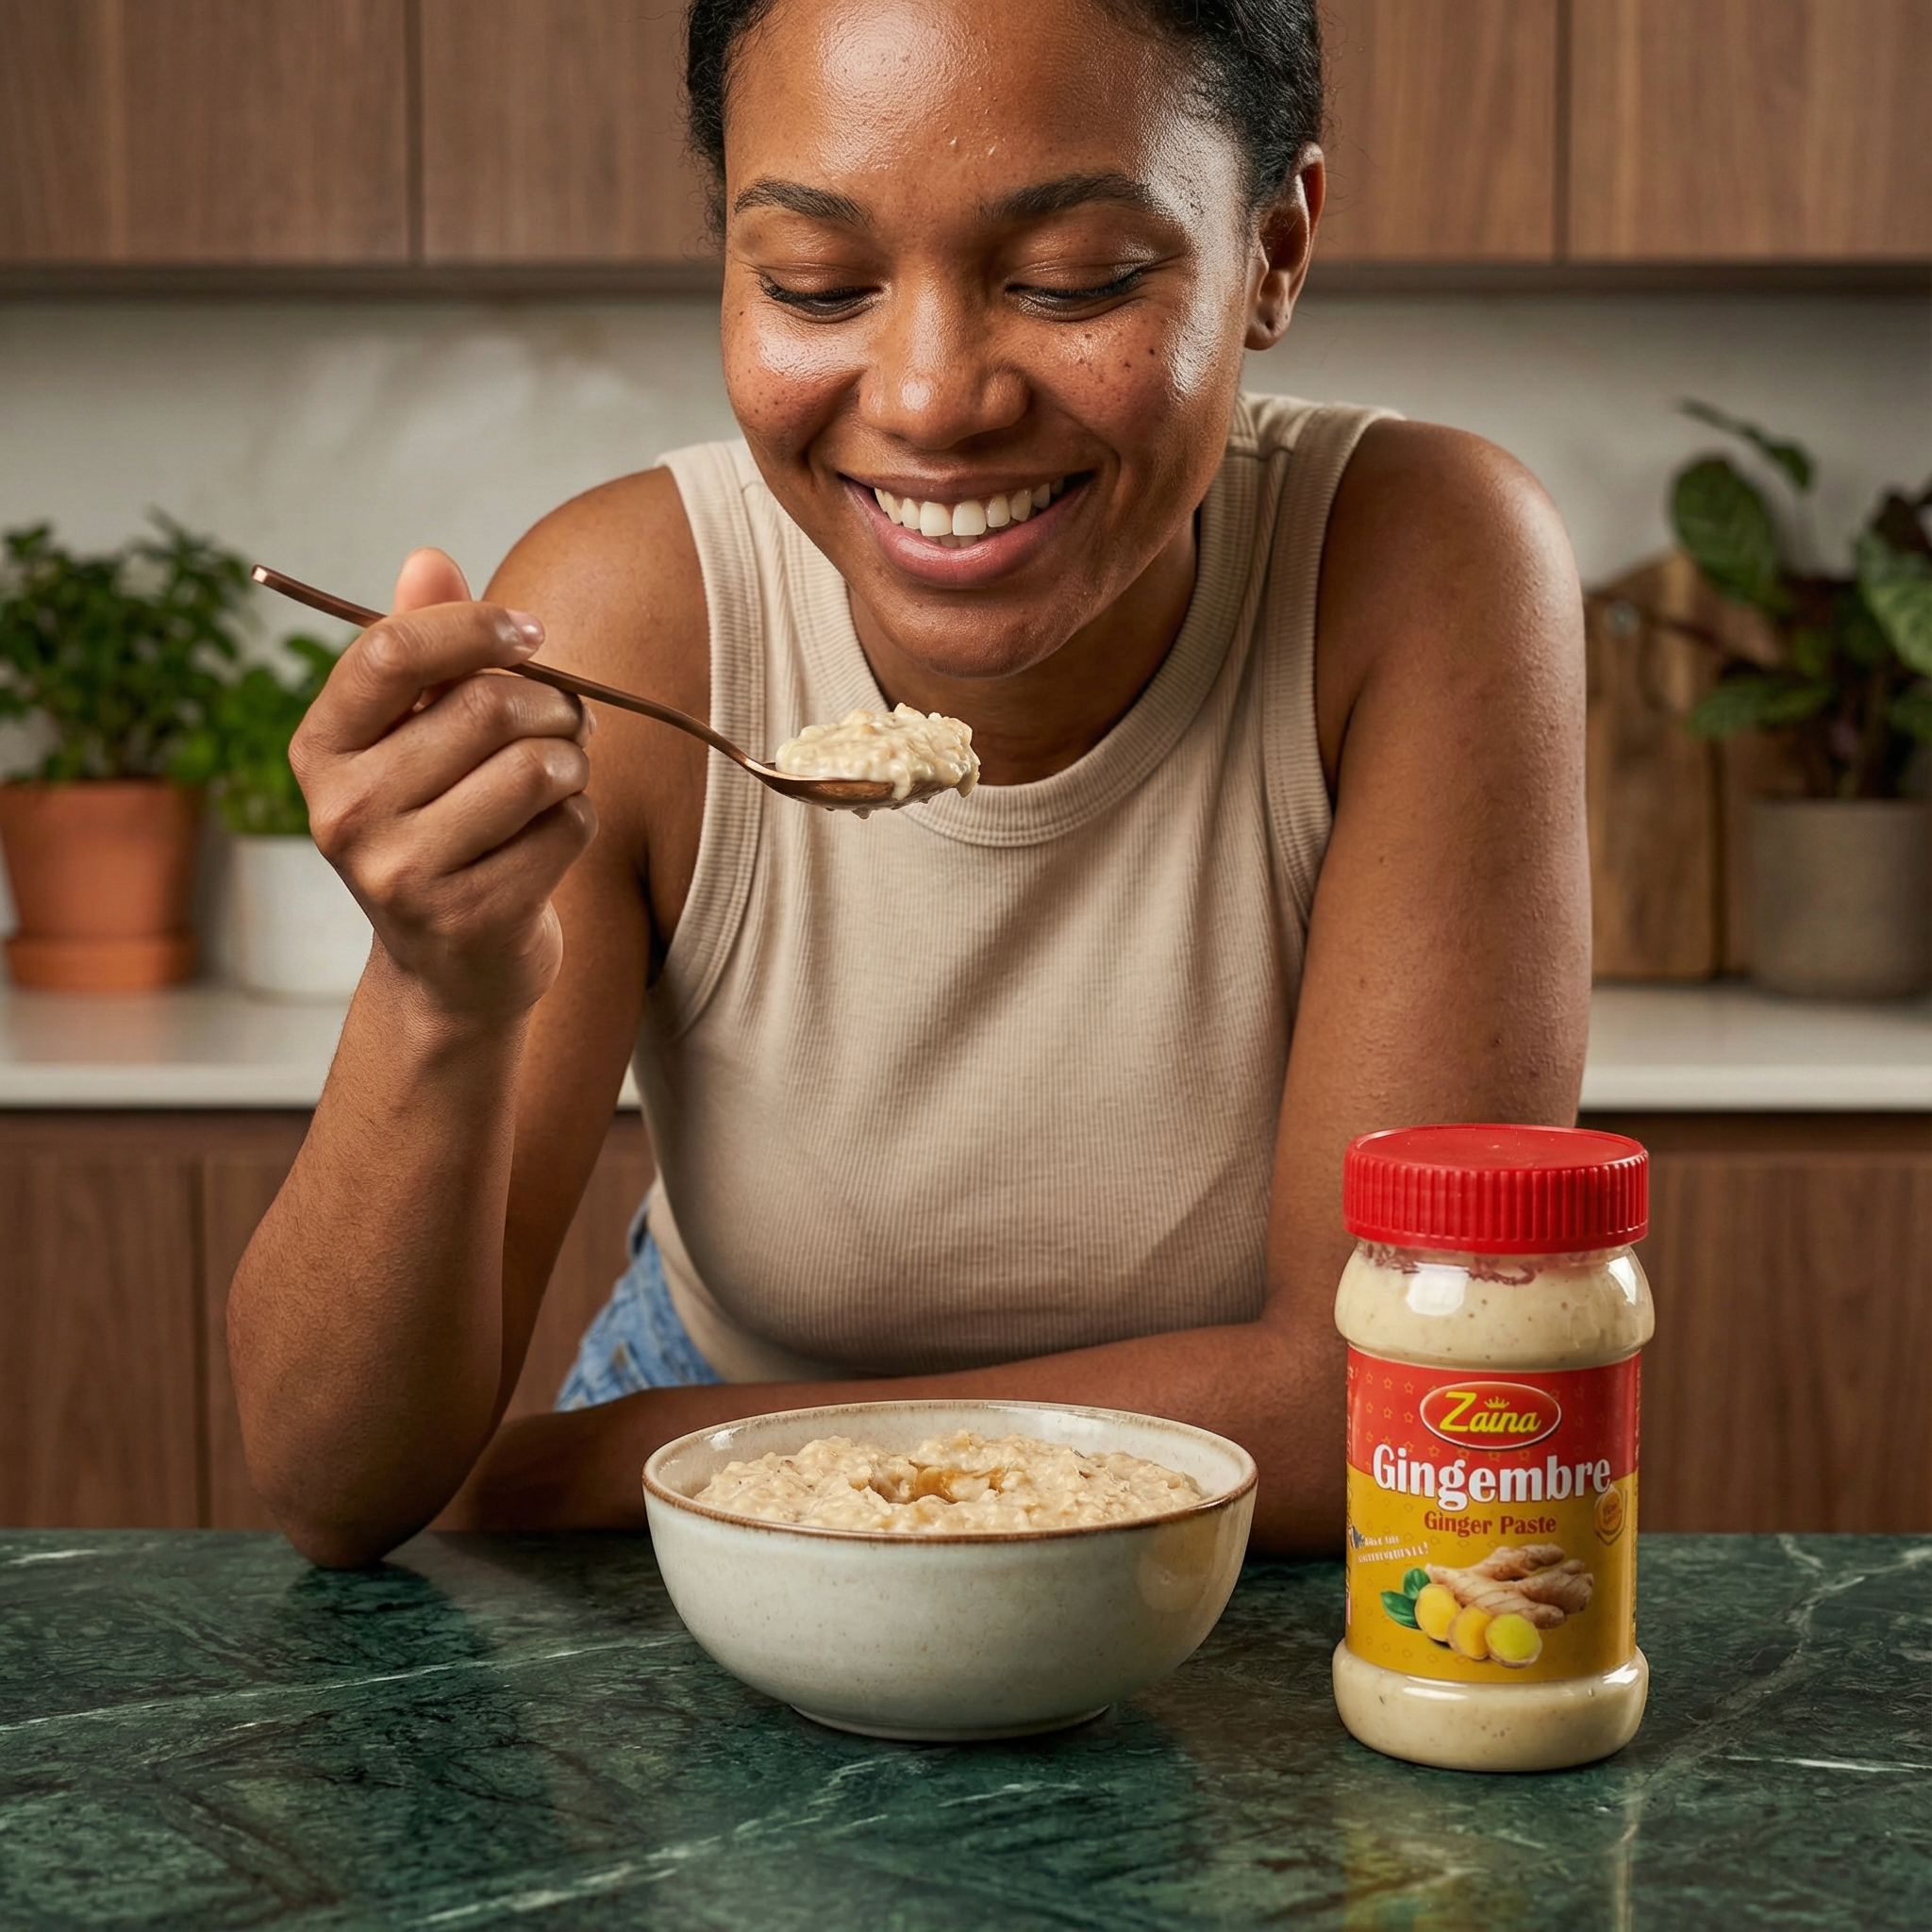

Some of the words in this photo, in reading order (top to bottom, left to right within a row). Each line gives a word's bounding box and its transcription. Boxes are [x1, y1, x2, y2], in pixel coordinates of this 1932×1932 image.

[1439, 1391, 1541, 1433] Zaina
[1373, 1443, 1610, 1511] Gingembre
[1424, 1510, 1491, 1538] Ginger
[1500, 1515, 1557, 1535] Paste
